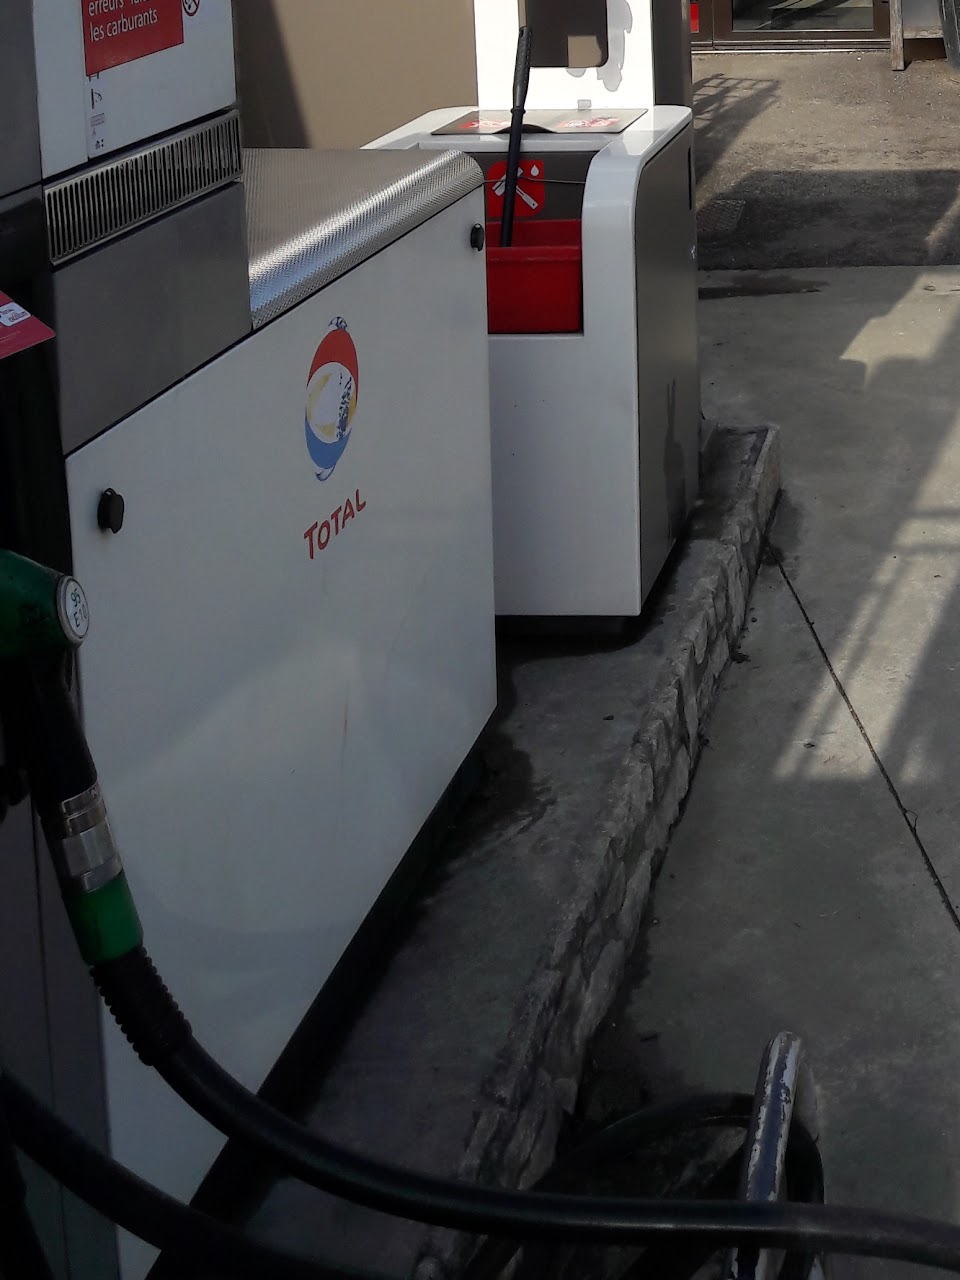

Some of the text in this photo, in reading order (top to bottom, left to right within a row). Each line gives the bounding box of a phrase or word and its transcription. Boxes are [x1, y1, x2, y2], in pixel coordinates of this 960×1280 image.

[90, 7, 158, 42] les carburants
[304, 488, 367, 561] TOTAL
